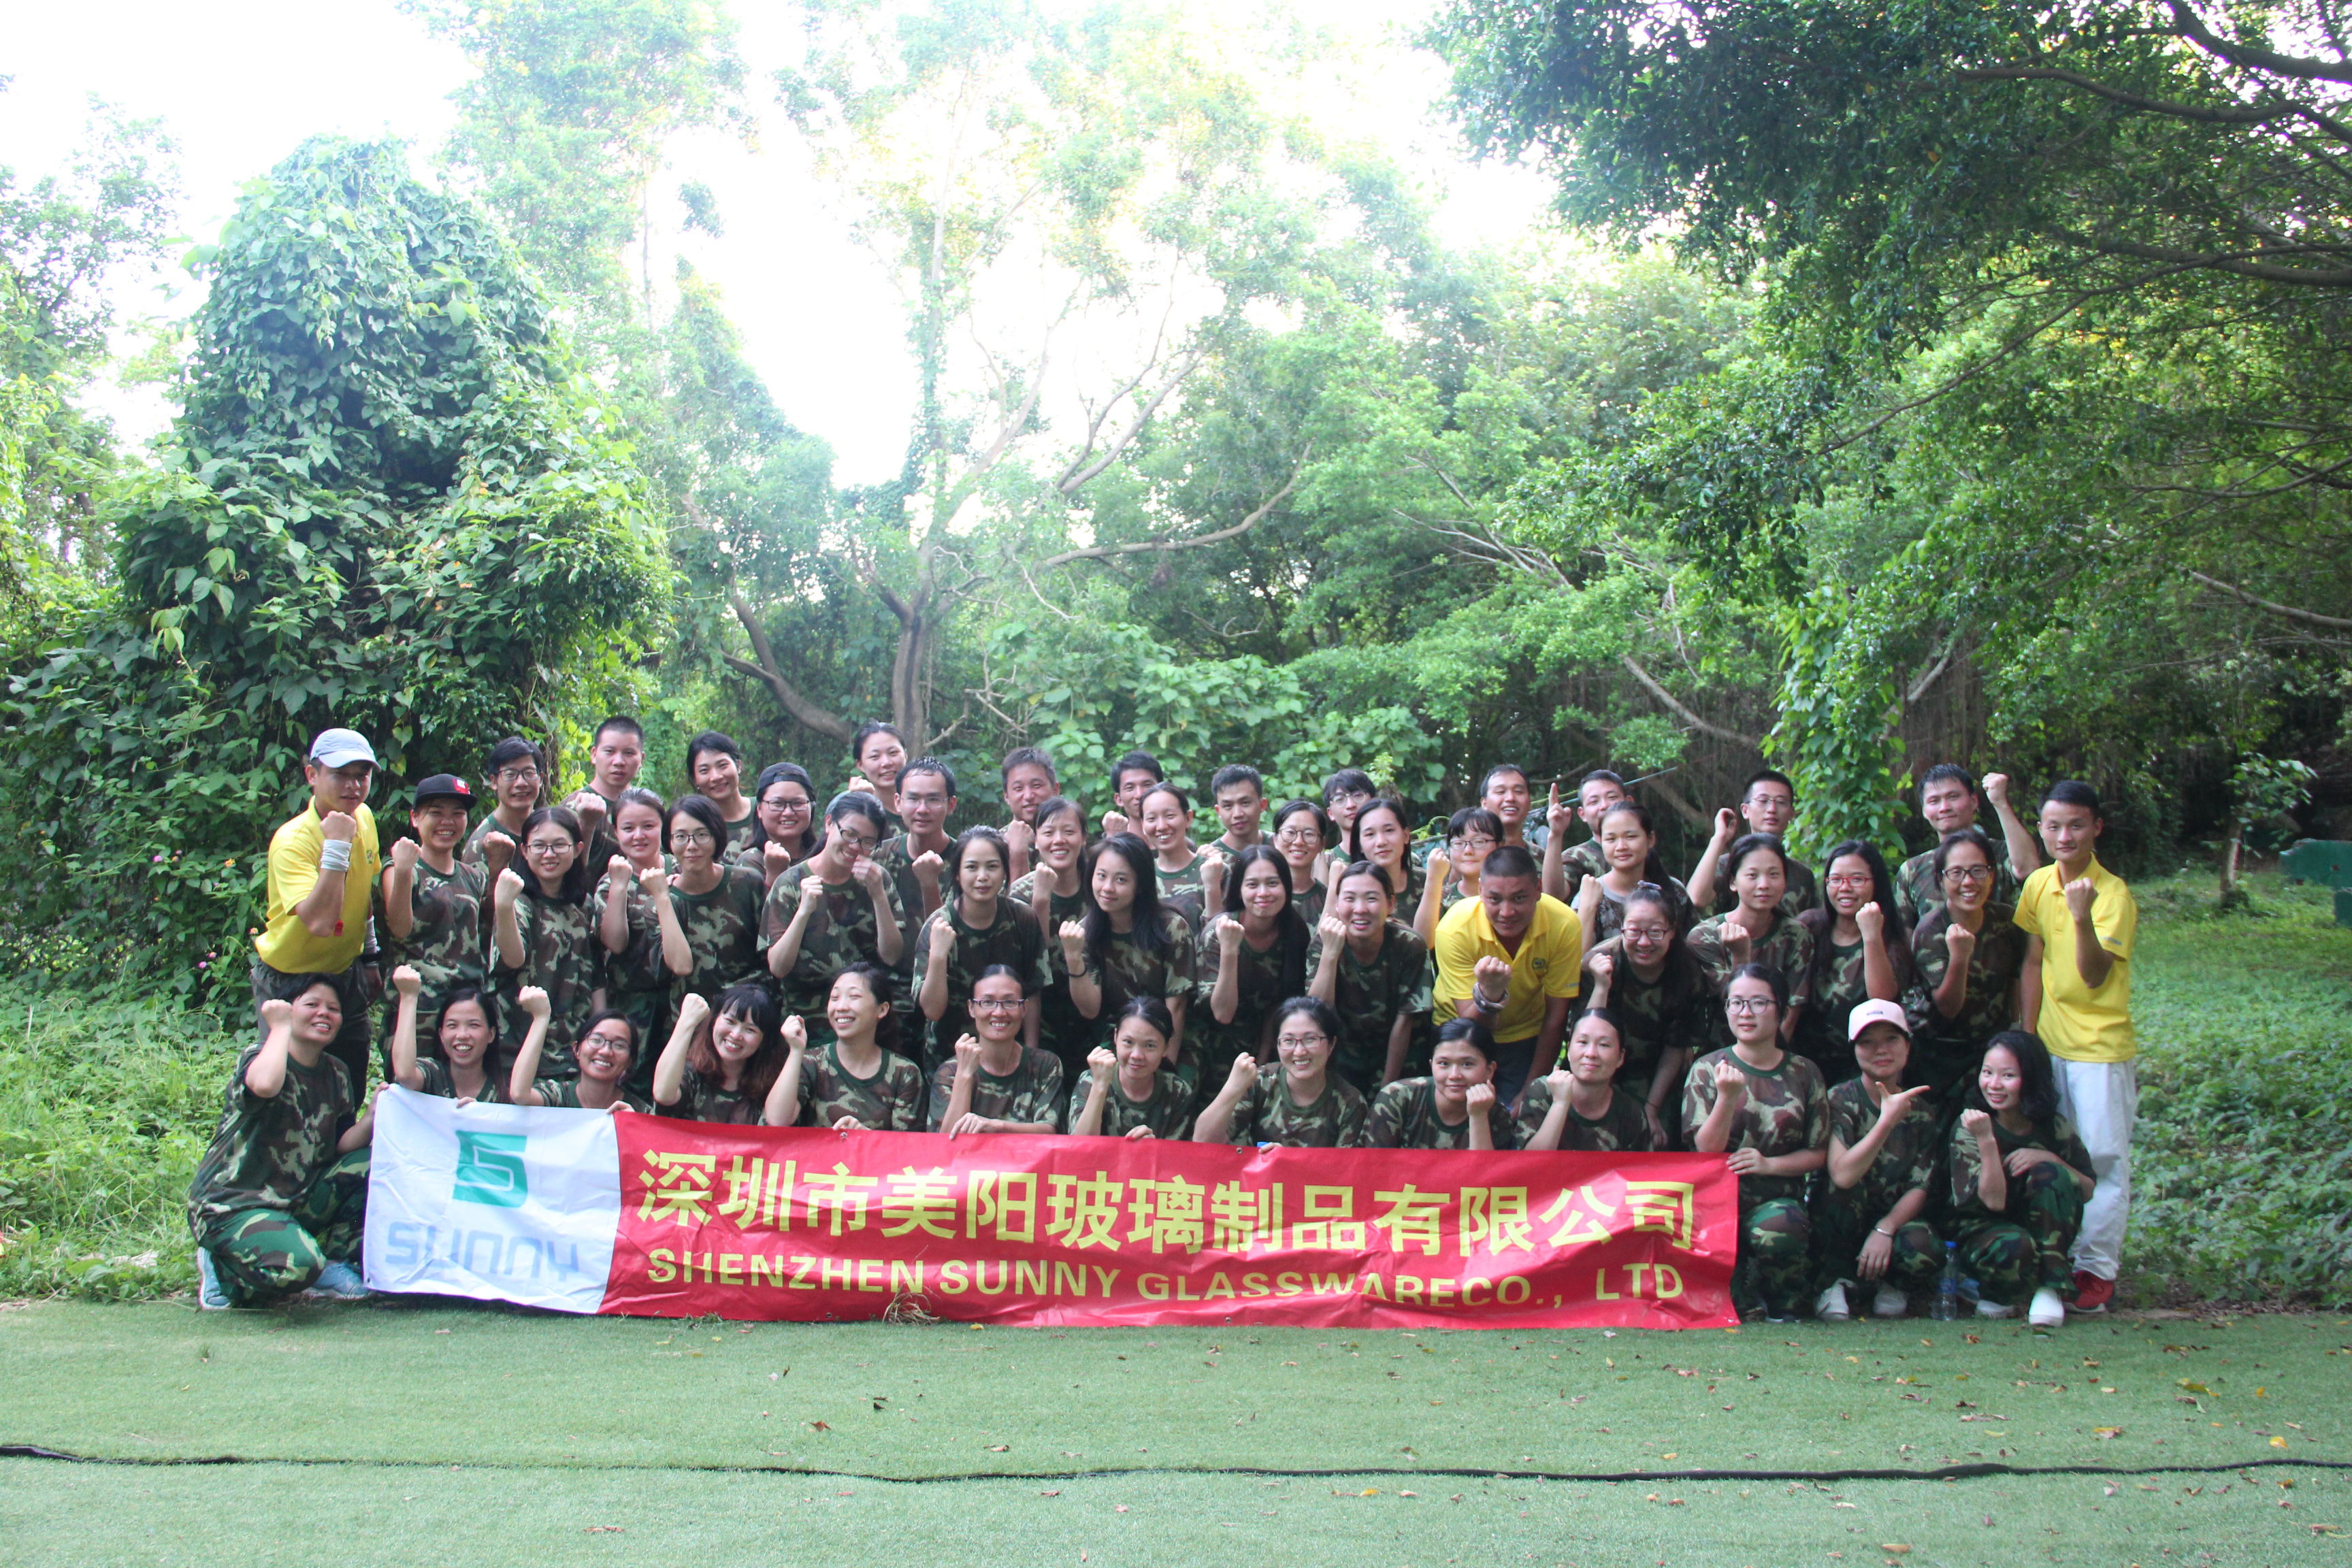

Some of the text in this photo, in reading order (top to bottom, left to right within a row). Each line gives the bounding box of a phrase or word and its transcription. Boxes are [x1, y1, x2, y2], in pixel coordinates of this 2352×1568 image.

[638, 1149, 1695, 1256] 深圳市美阳玻璃制品有限公司
[648, 1248, 924, 1294] SHENZHEN
[940, 1259, 1122, 1298] SUNNY
[1595, 1262, 1684, 1301] LTD
